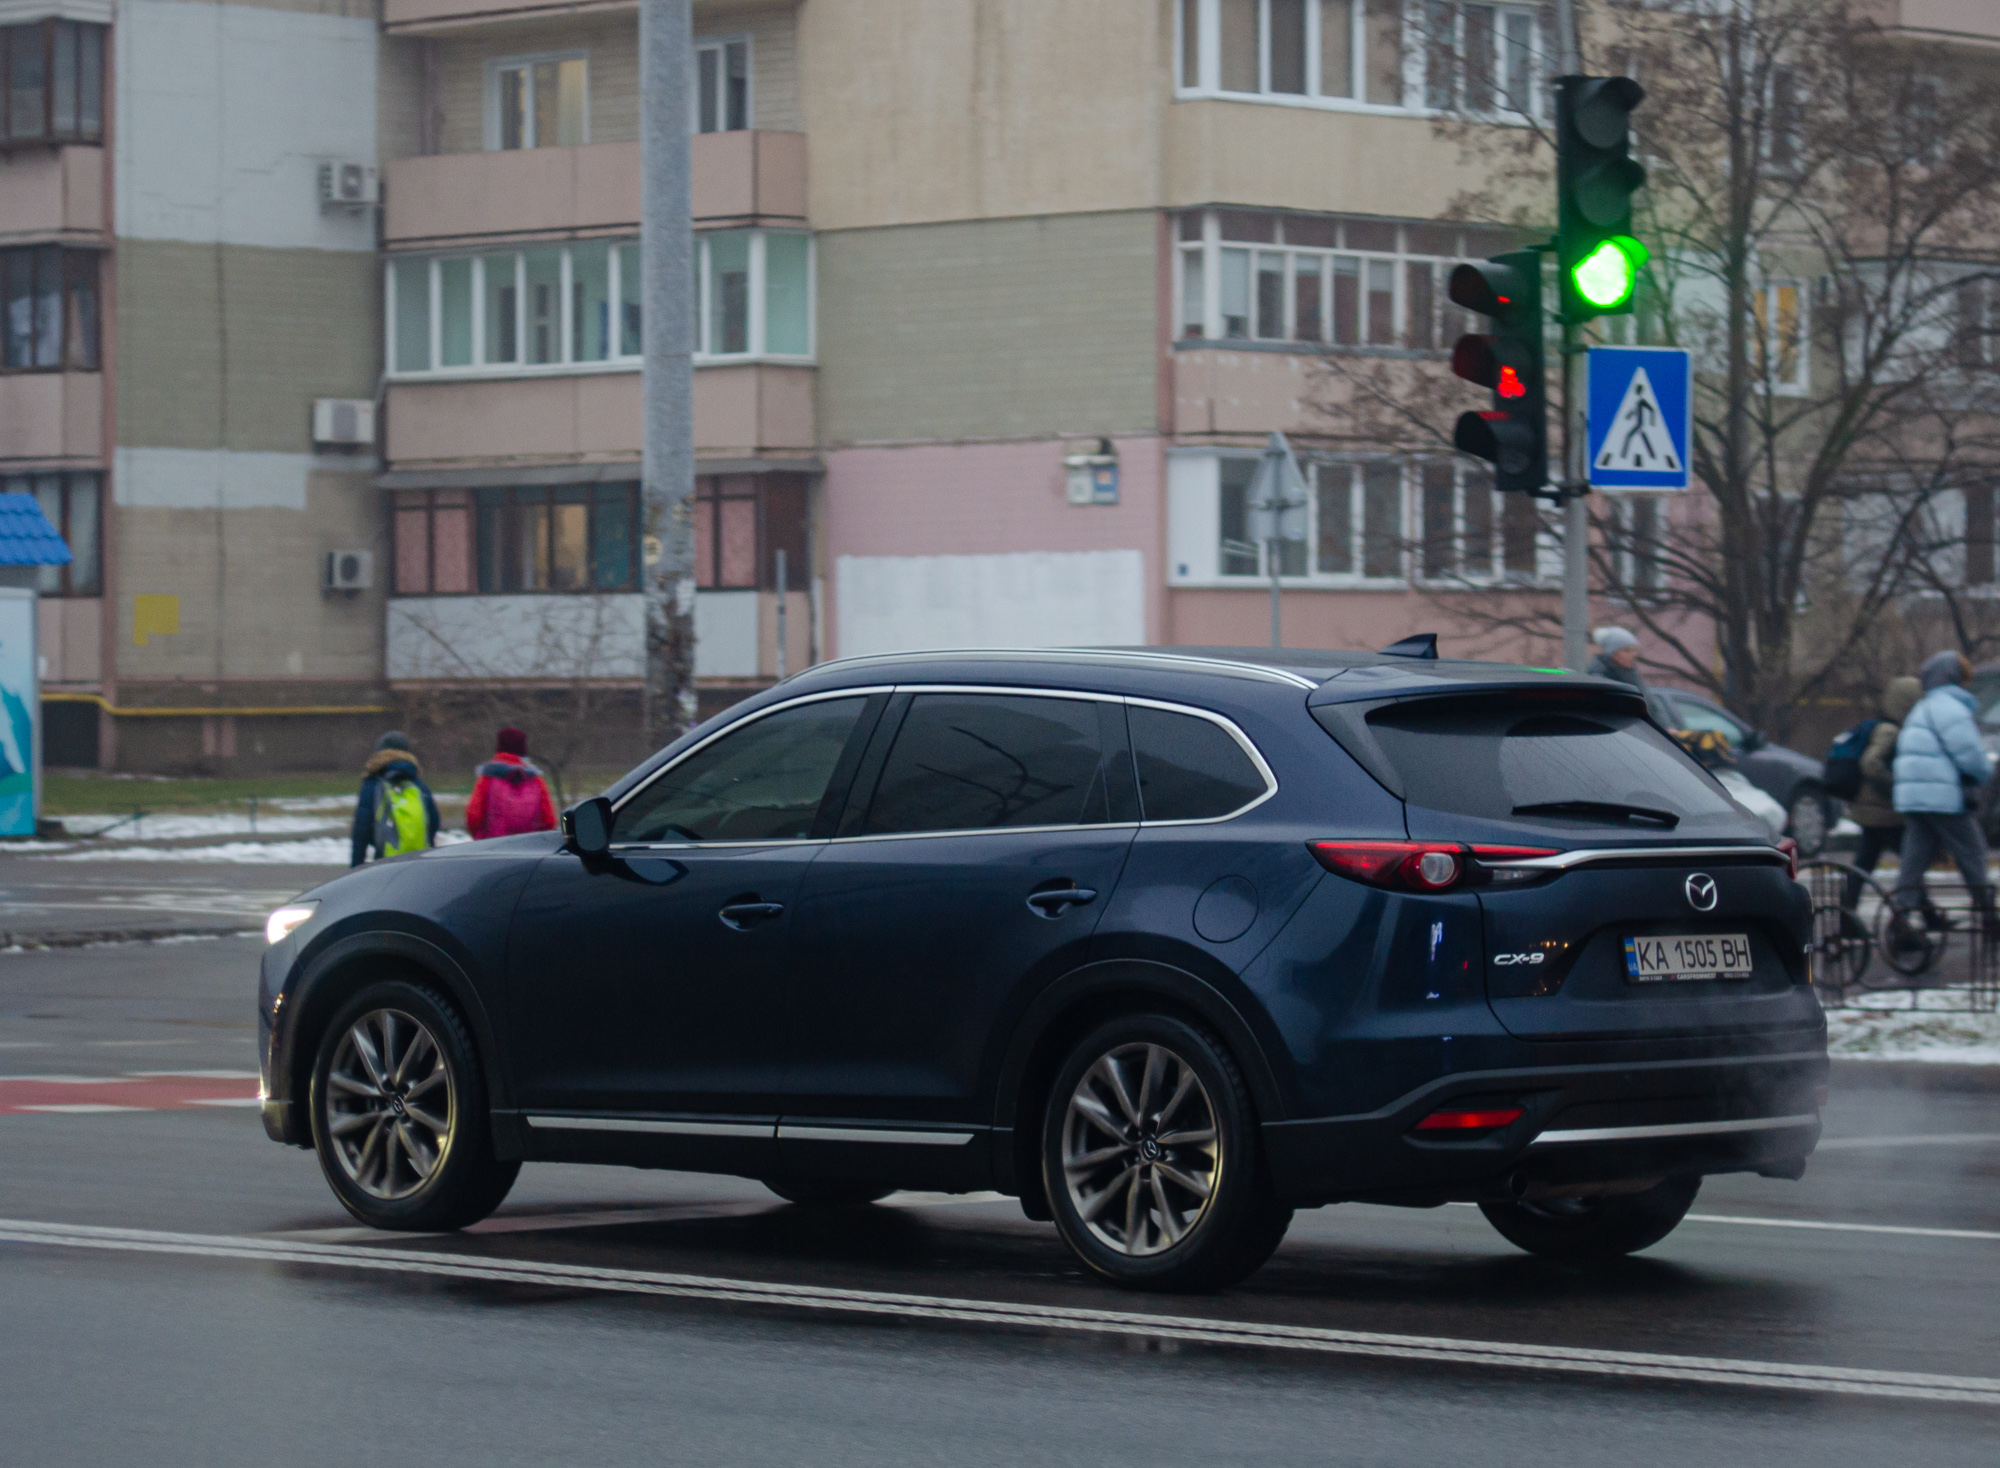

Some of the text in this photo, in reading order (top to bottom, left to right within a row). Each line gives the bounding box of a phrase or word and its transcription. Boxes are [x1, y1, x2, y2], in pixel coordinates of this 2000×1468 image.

[1494, 952, 1545, 965] CX-9
[1638, 939, 1750, 970] KA 1505 BH
